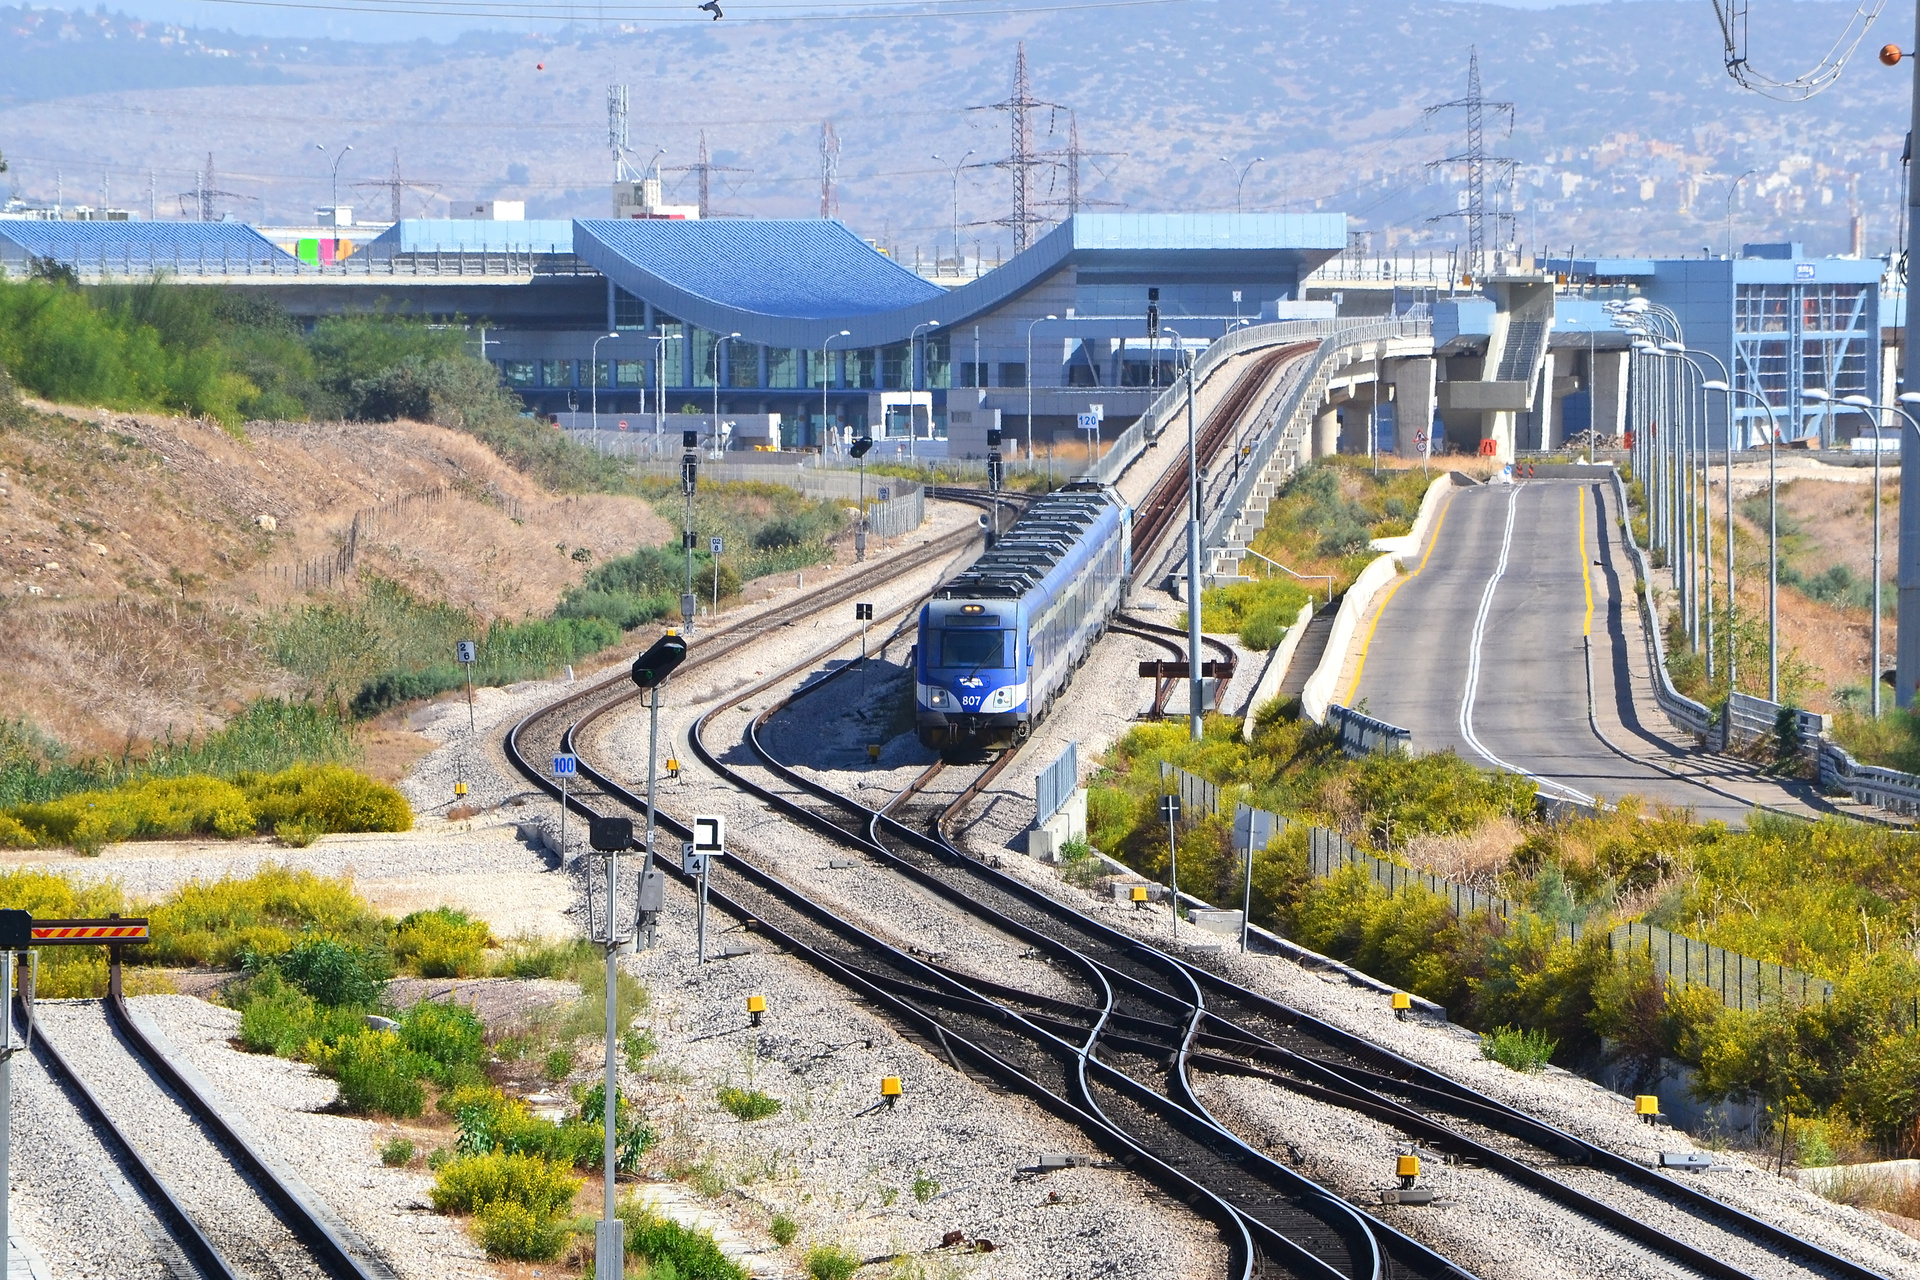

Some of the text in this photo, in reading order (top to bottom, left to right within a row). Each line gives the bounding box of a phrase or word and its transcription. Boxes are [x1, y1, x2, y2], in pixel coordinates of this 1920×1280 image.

[1079, 415, 1097, 426] 120
[460, 643, 466, 651] 2
[464, 652, 470, 660] 6
[962, 695, 981, 706] 807
[554, 757, 574, 773] 100
[692, 859, 701, 871] 4
